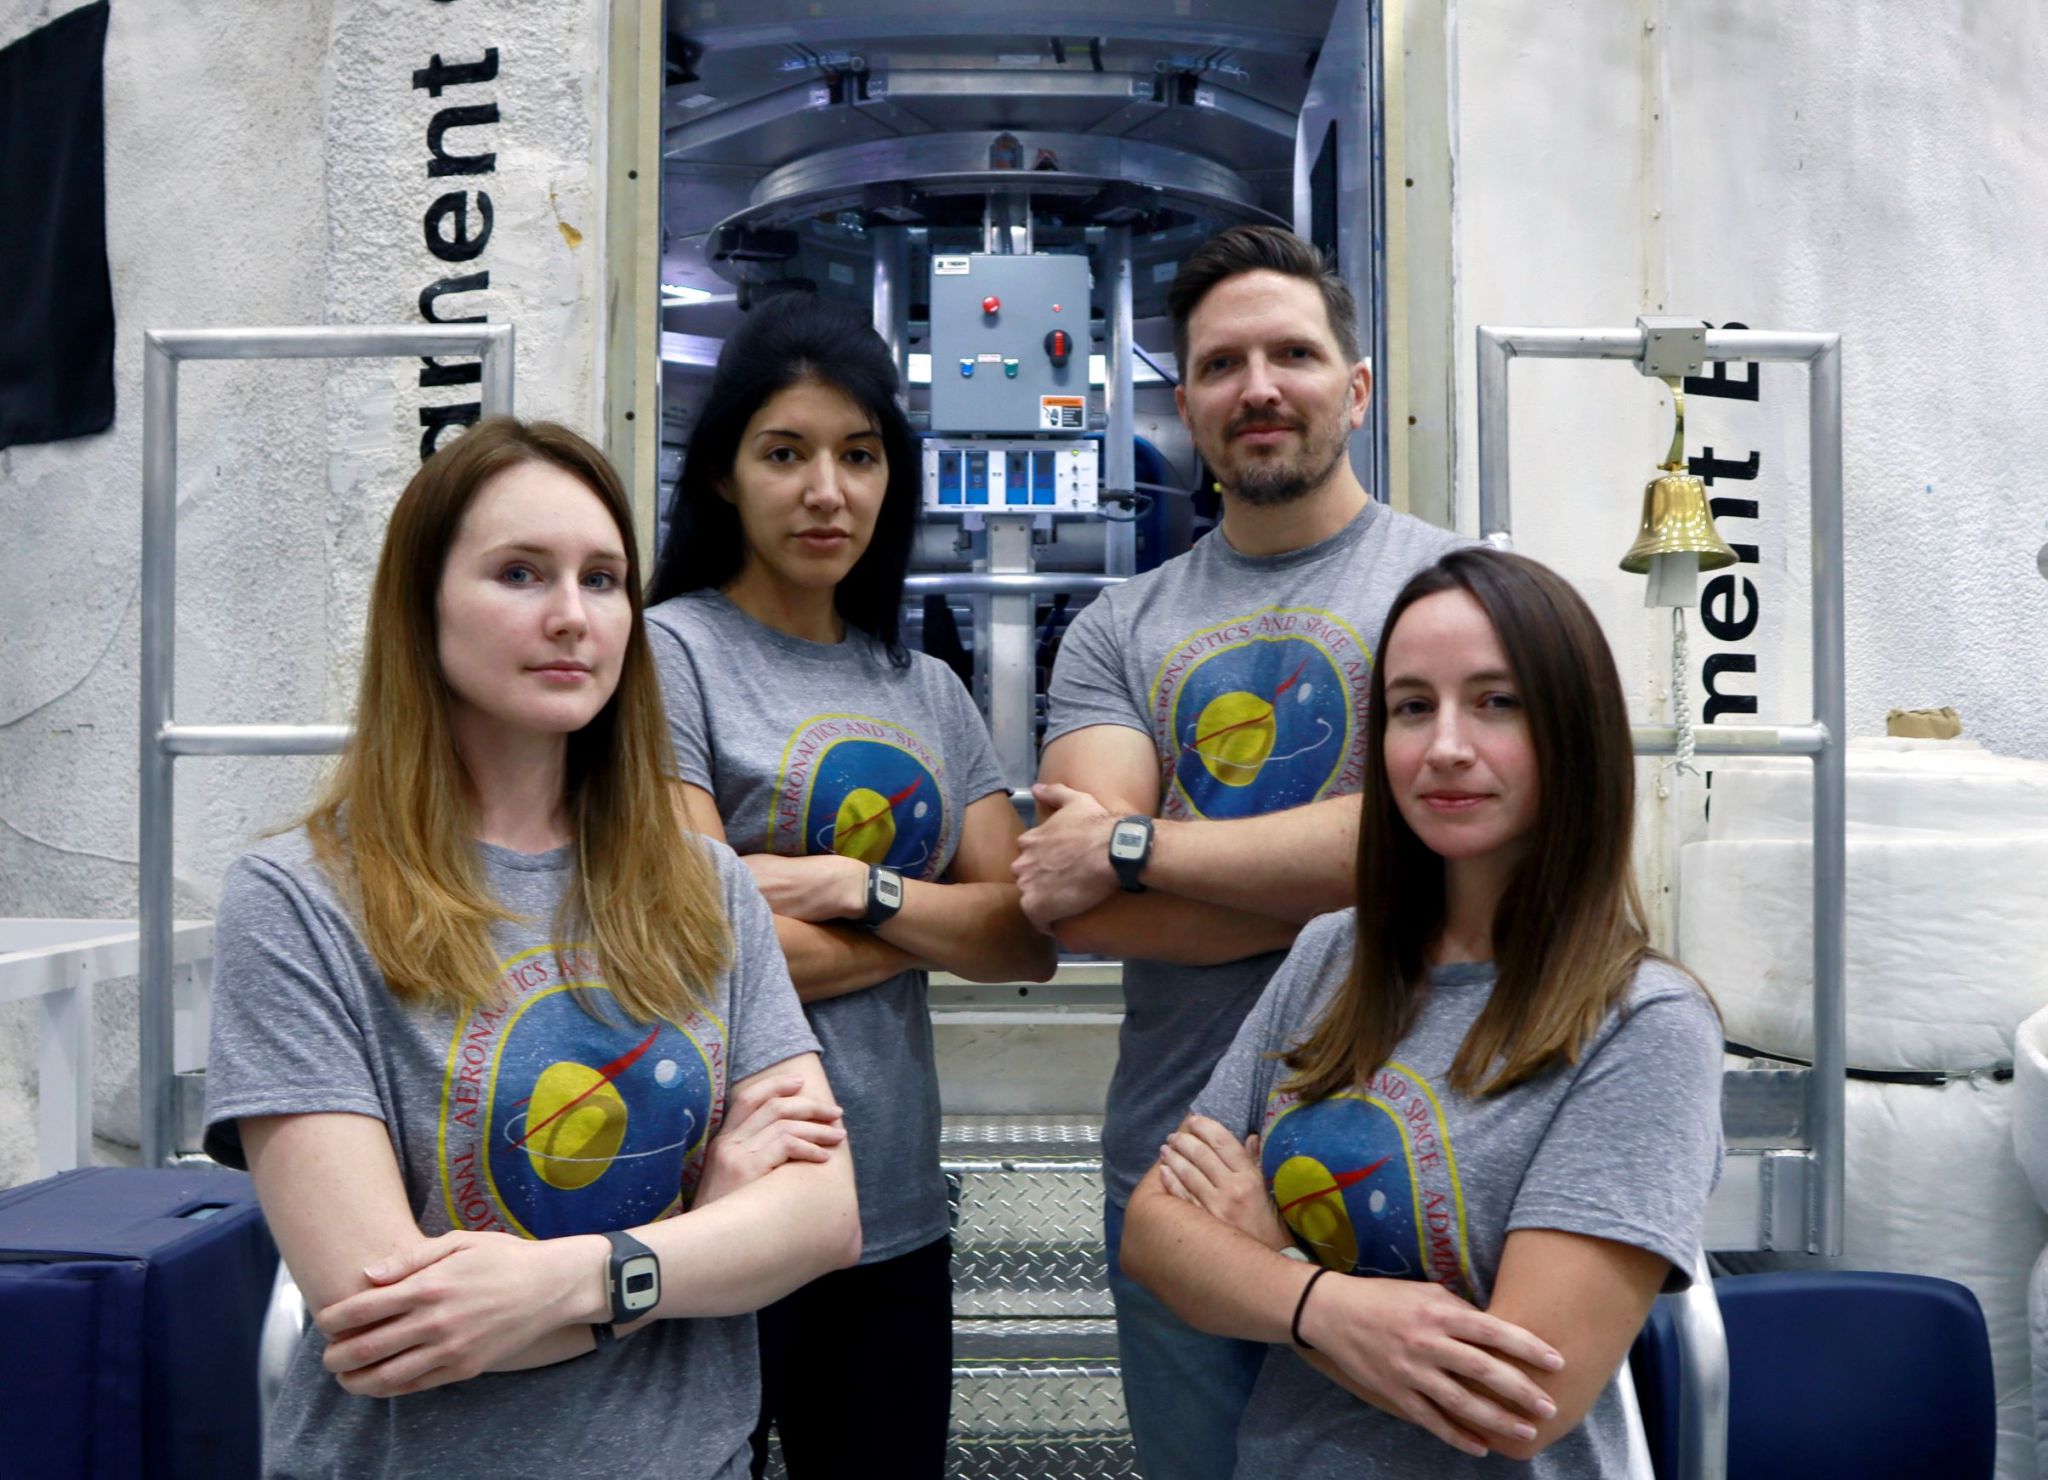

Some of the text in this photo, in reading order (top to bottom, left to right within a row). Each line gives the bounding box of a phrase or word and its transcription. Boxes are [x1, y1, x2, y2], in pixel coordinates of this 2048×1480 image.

[1257, 615, 1298, 633] AND
[779, 722, 841, 834] AERONAUTICS
[847, 722, 886, 738] AND
[558, 953, 606, 978] AN
[1403, 1098, 1441, 1173] SPACE
